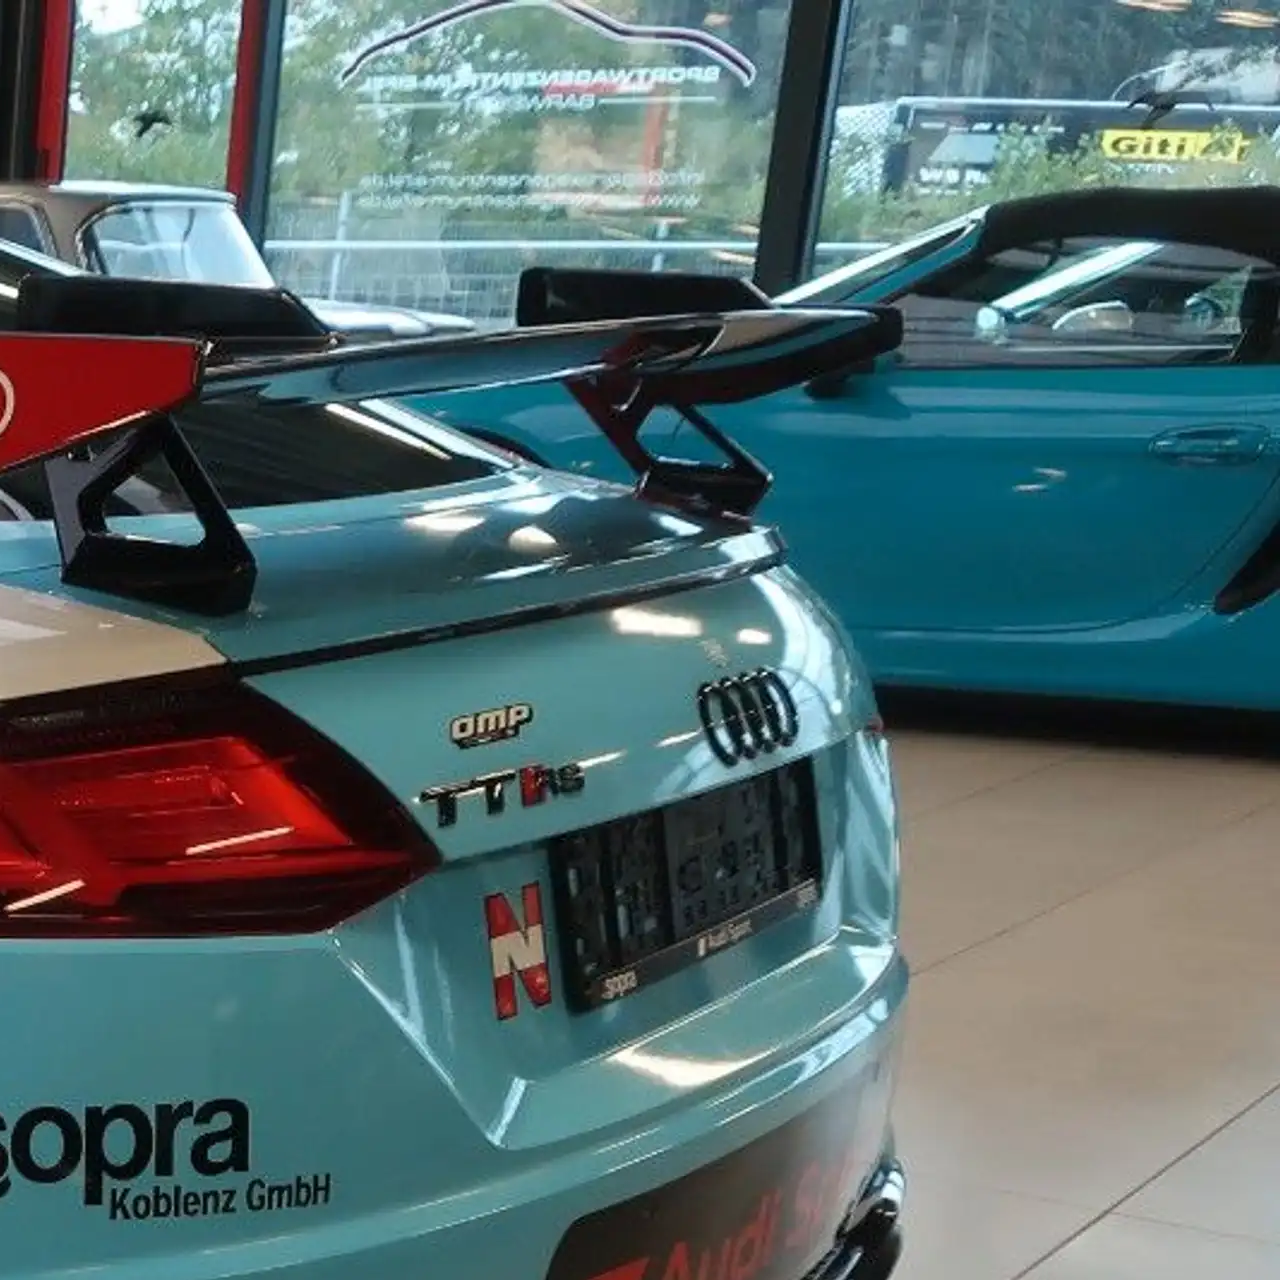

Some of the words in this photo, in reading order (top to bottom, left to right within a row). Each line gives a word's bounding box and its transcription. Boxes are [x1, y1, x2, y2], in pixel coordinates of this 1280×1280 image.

[1110, 134, 1187, 158] Giti
[108, 1187, 237, 1221] Koblenz
[245, 1173, 332, 1211] GmbH
